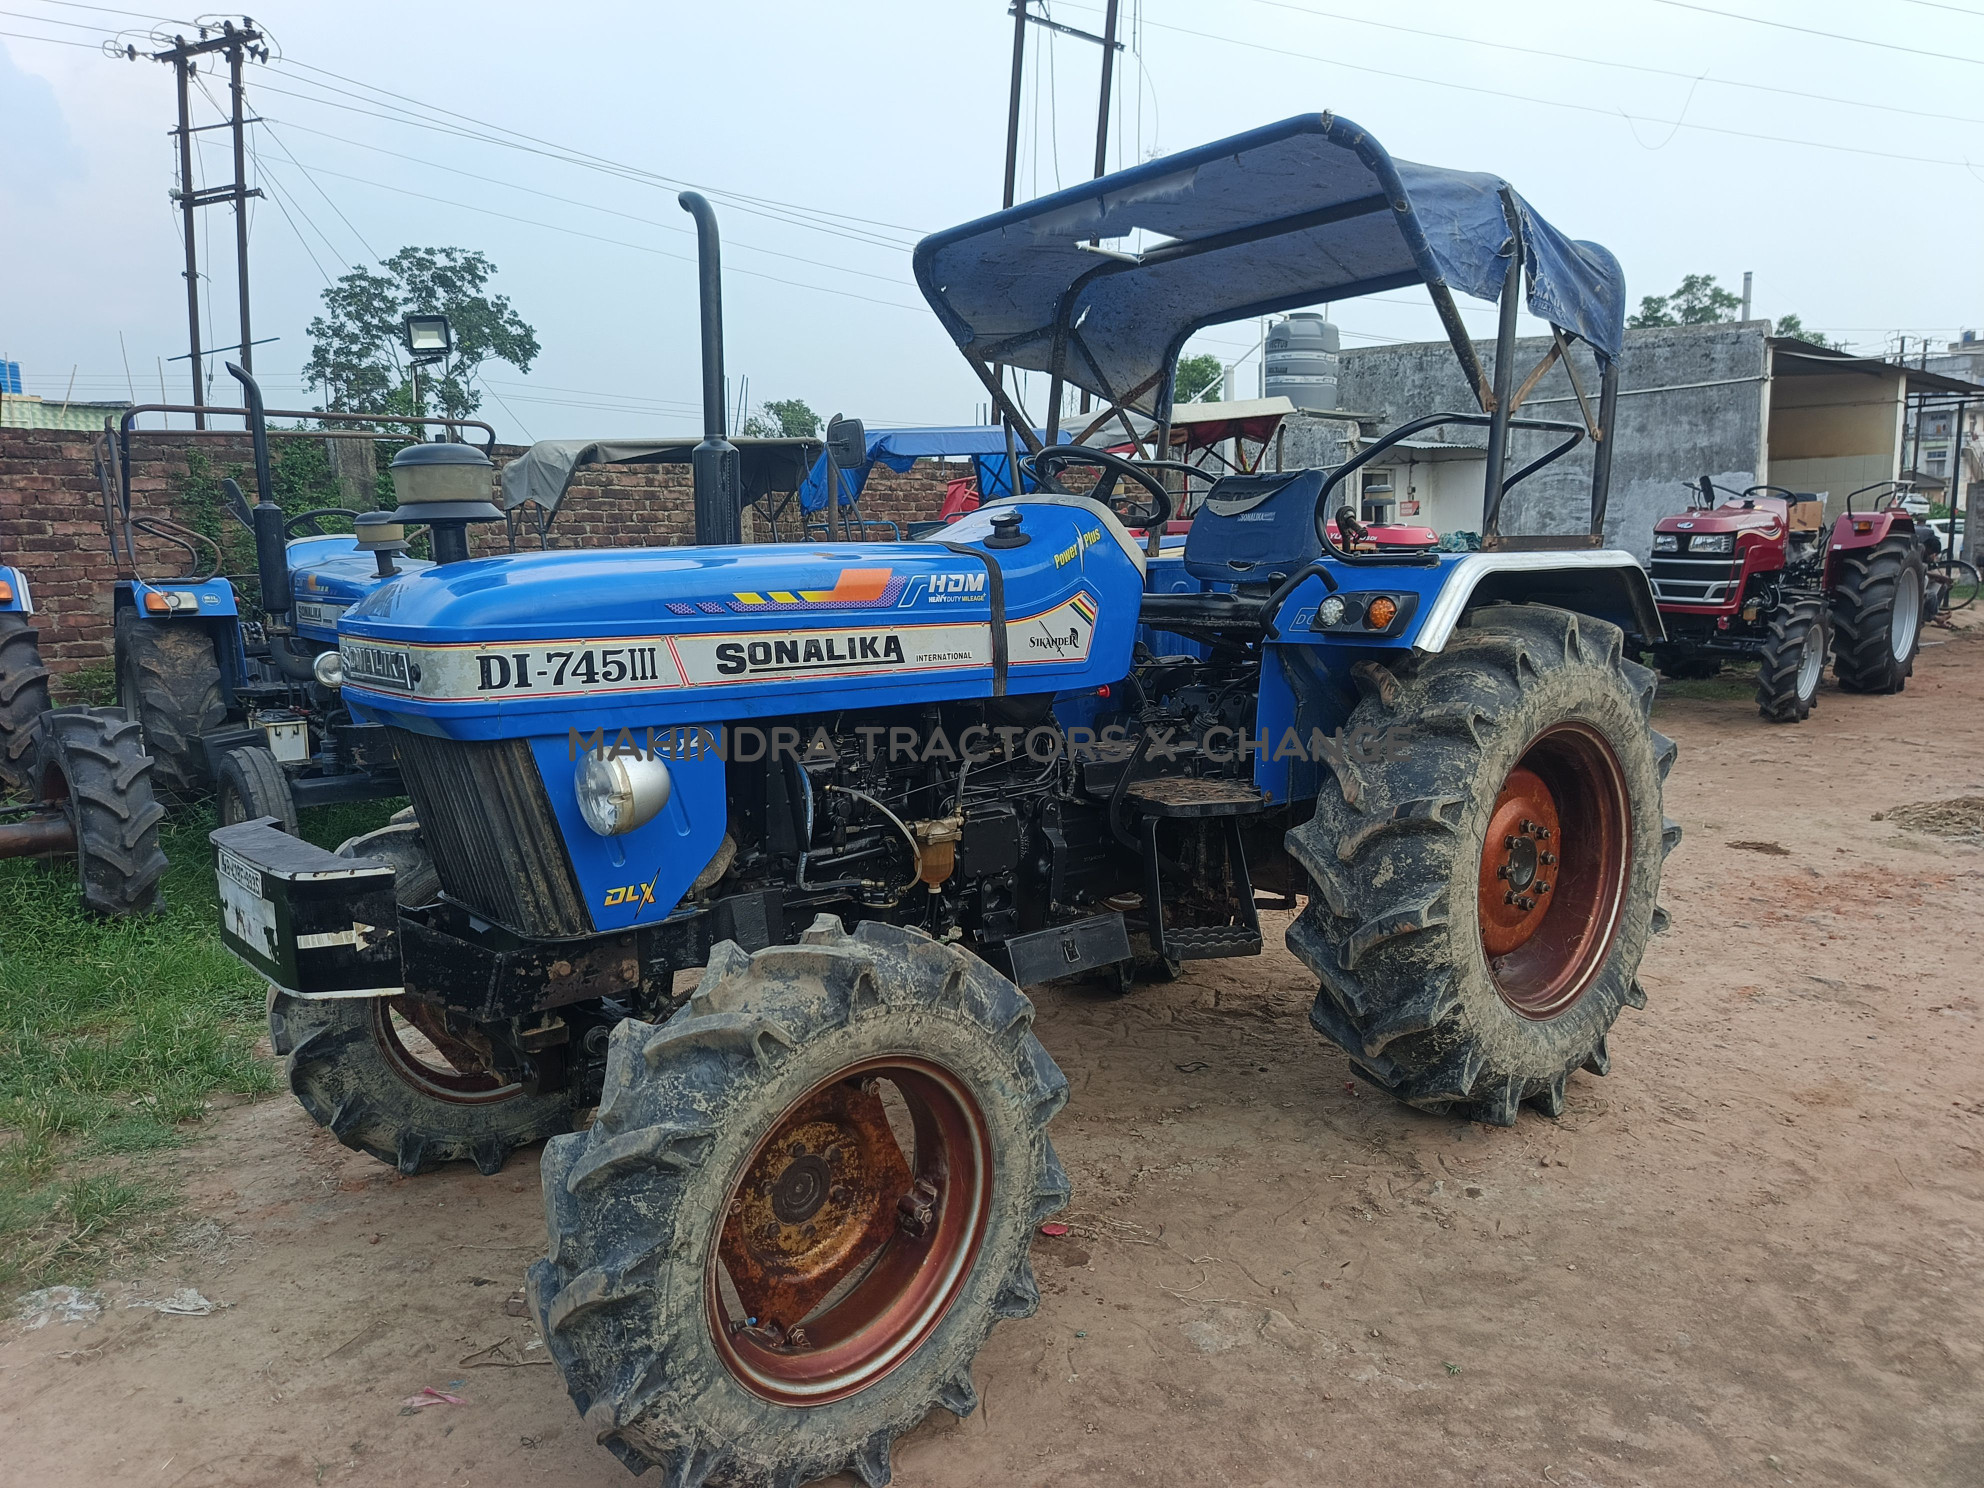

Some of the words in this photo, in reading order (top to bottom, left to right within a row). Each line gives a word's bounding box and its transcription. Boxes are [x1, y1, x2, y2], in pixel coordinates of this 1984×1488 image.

[1053, 543, 1078, 570] Power
[1083, 528, 1101, 548] Plus
[928, 573, 985, 593] HDM
[715, 635, 906, 676] SONALIKA
[915, 651, 973, 663] INTERNATIONAL
[1029, 629, 1080, 650] SIKANDER
[341, 646, 415, 691] SONALIKA
[604, 872, 659, 914] DLX
